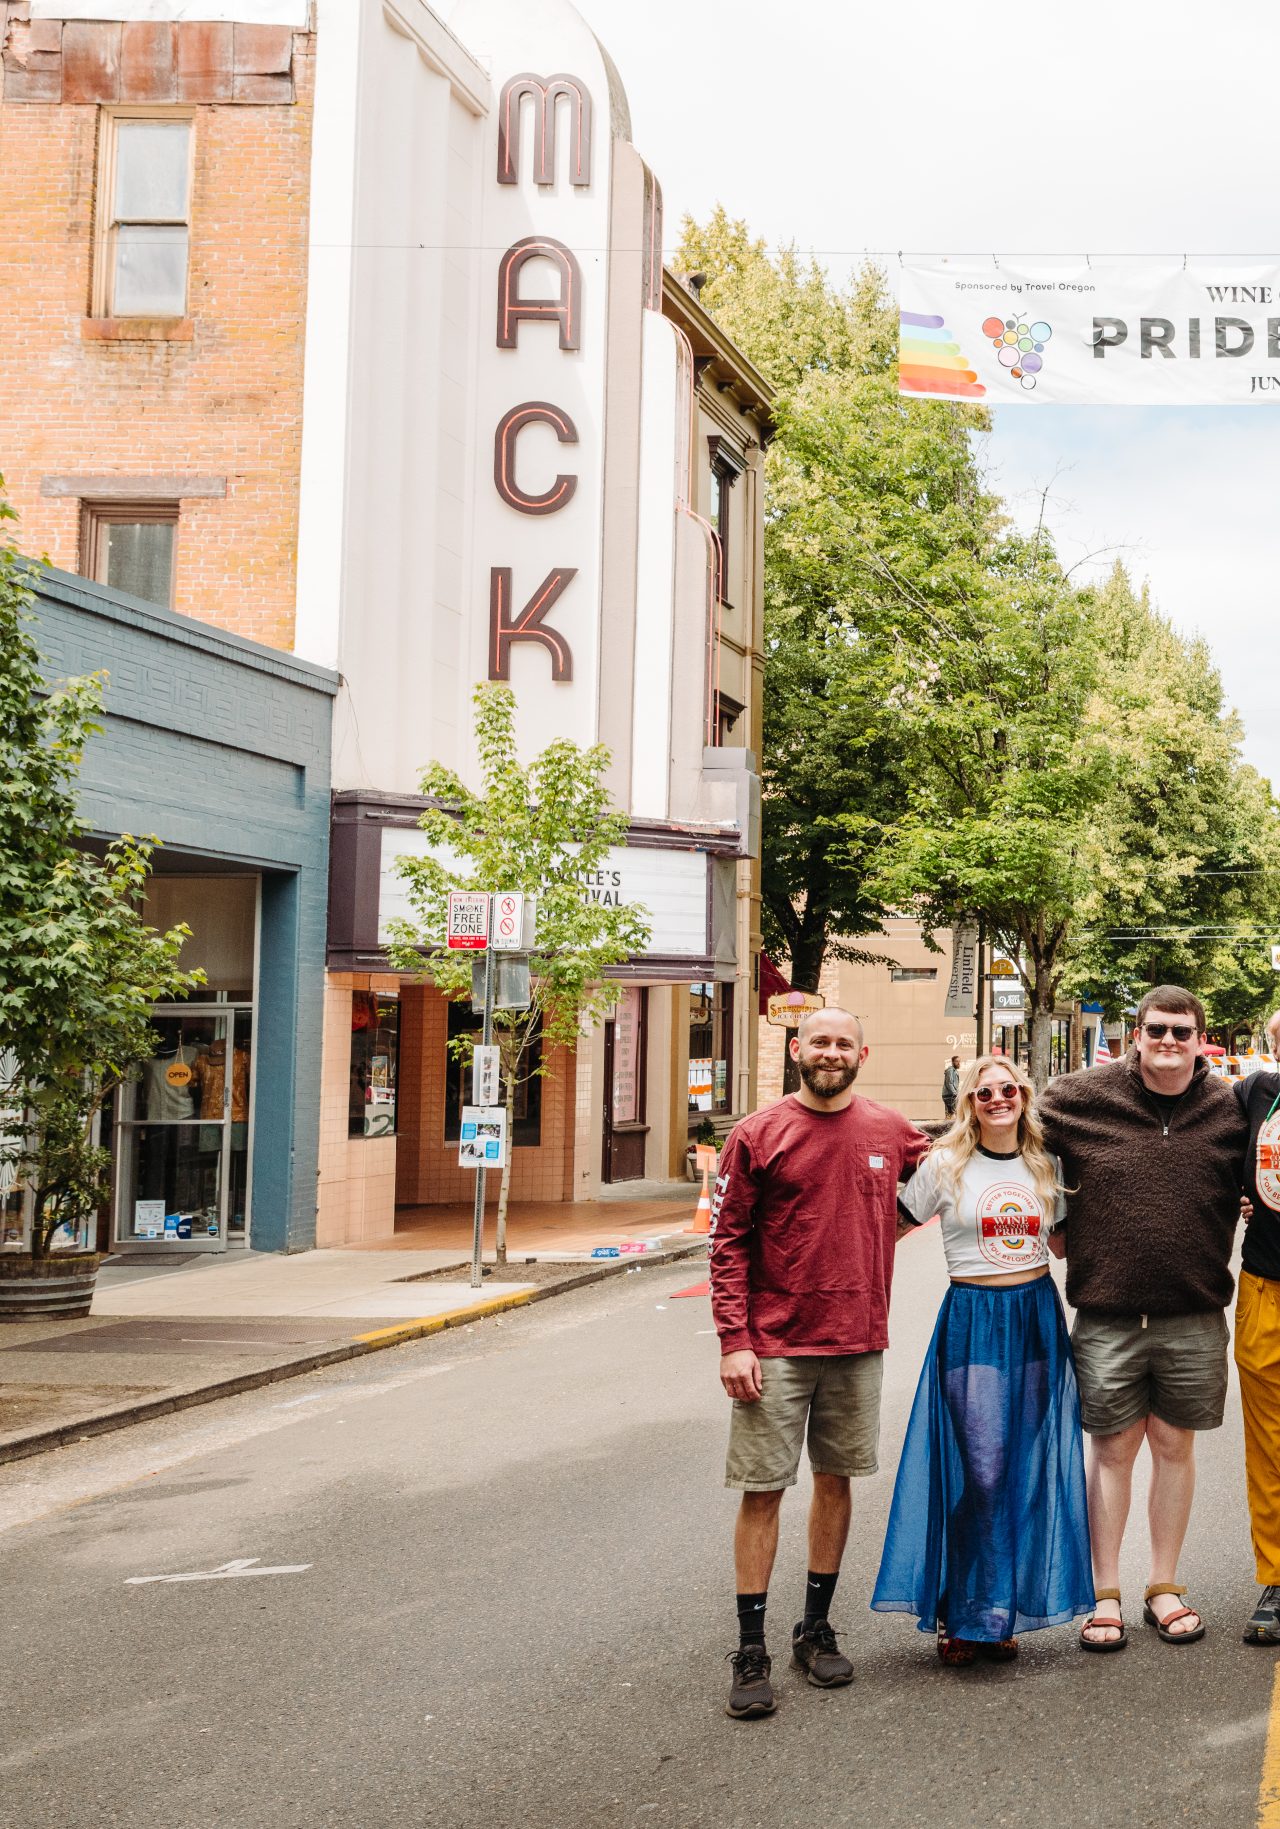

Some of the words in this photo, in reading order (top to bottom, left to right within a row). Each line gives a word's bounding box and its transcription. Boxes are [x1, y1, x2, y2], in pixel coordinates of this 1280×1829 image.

[954, 281, 1008, 291] Sponsored
[1010, 283, 1022, 293] by
[1025, 282, 1056, 291] Travel
[1058, 282, 1096, 292] Oregon
[1206, 286, 1272, 304] WINE
[488, 72, 592, 682] MACK
[454, 914, 483, 924] FREE
[453, 924, 483, 934] ZONE
[962, 946, 974, 994] Linfield
[168, 1071, 188, 1079] OPEN
[1264, 1176, 1272, 1193] YOU
[986, 1193, 1002, 1211] BETTER
[1003, 1191, 1034, 1210] TOGETHER
[993, 1216, 1028, 1225] WINE
[989, 1243, 1000, 1255] YOU
